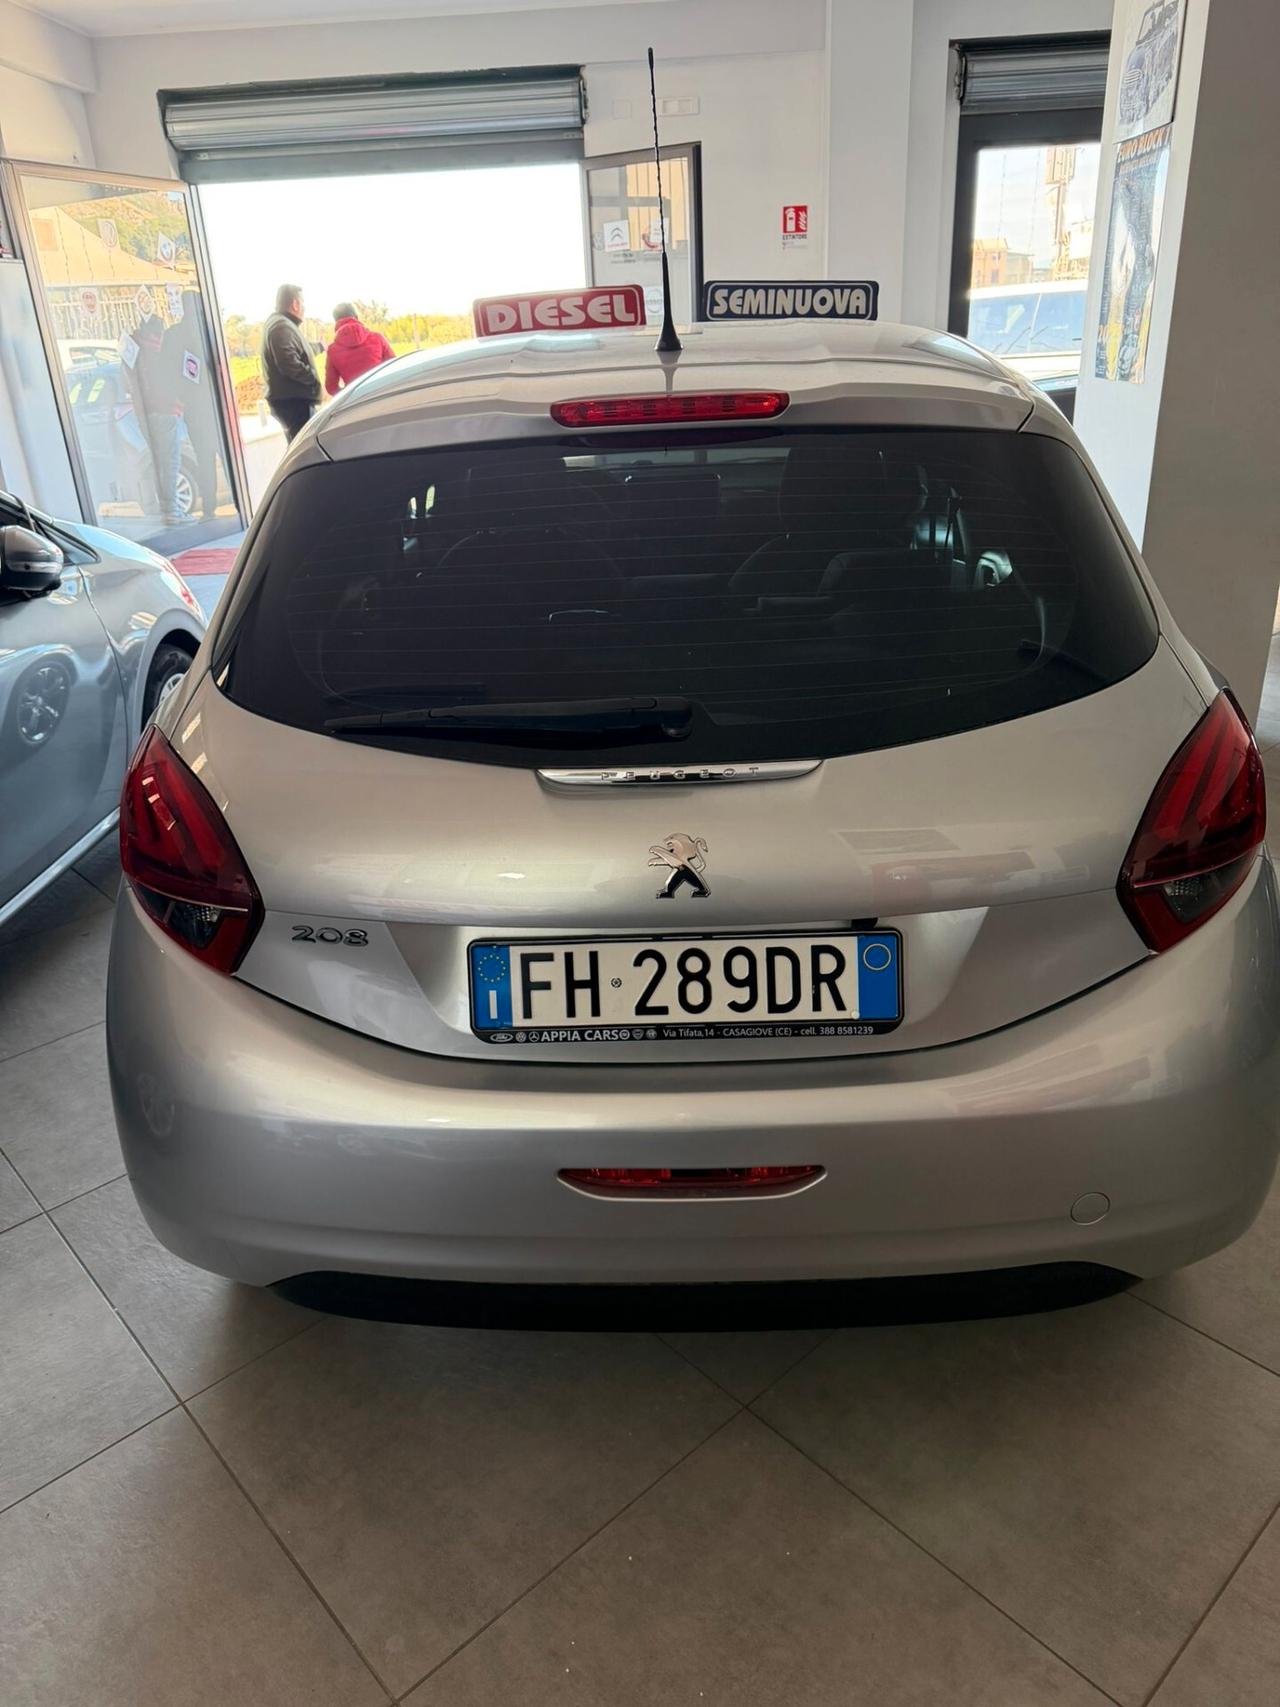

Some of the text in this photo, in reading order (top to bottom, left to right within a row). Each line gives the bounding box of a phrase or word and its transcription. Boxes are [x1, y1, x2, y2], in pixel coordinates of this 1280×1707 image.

[486, 294, 635, 333] DIESEL
[713, 288, 867, 315] SEMINUOVA
[601, 767, 759, 780] PEUGEOT
[291, 925, 369, 946] 208
[520, 945, 847, 1019] FH 289DR
[489, 990, 498, 1019] I
[541, 1029, 619, 1042] APPIA CARS
[663, 1029, 677, 1037] Via
[722, 1027, 773, 1037] CASAGIOVE
[775, 1027, 792, 1037] (CE)
[819, 1026, 836, 1035] 388
[837, 1026, 874, 1035] 8581239
